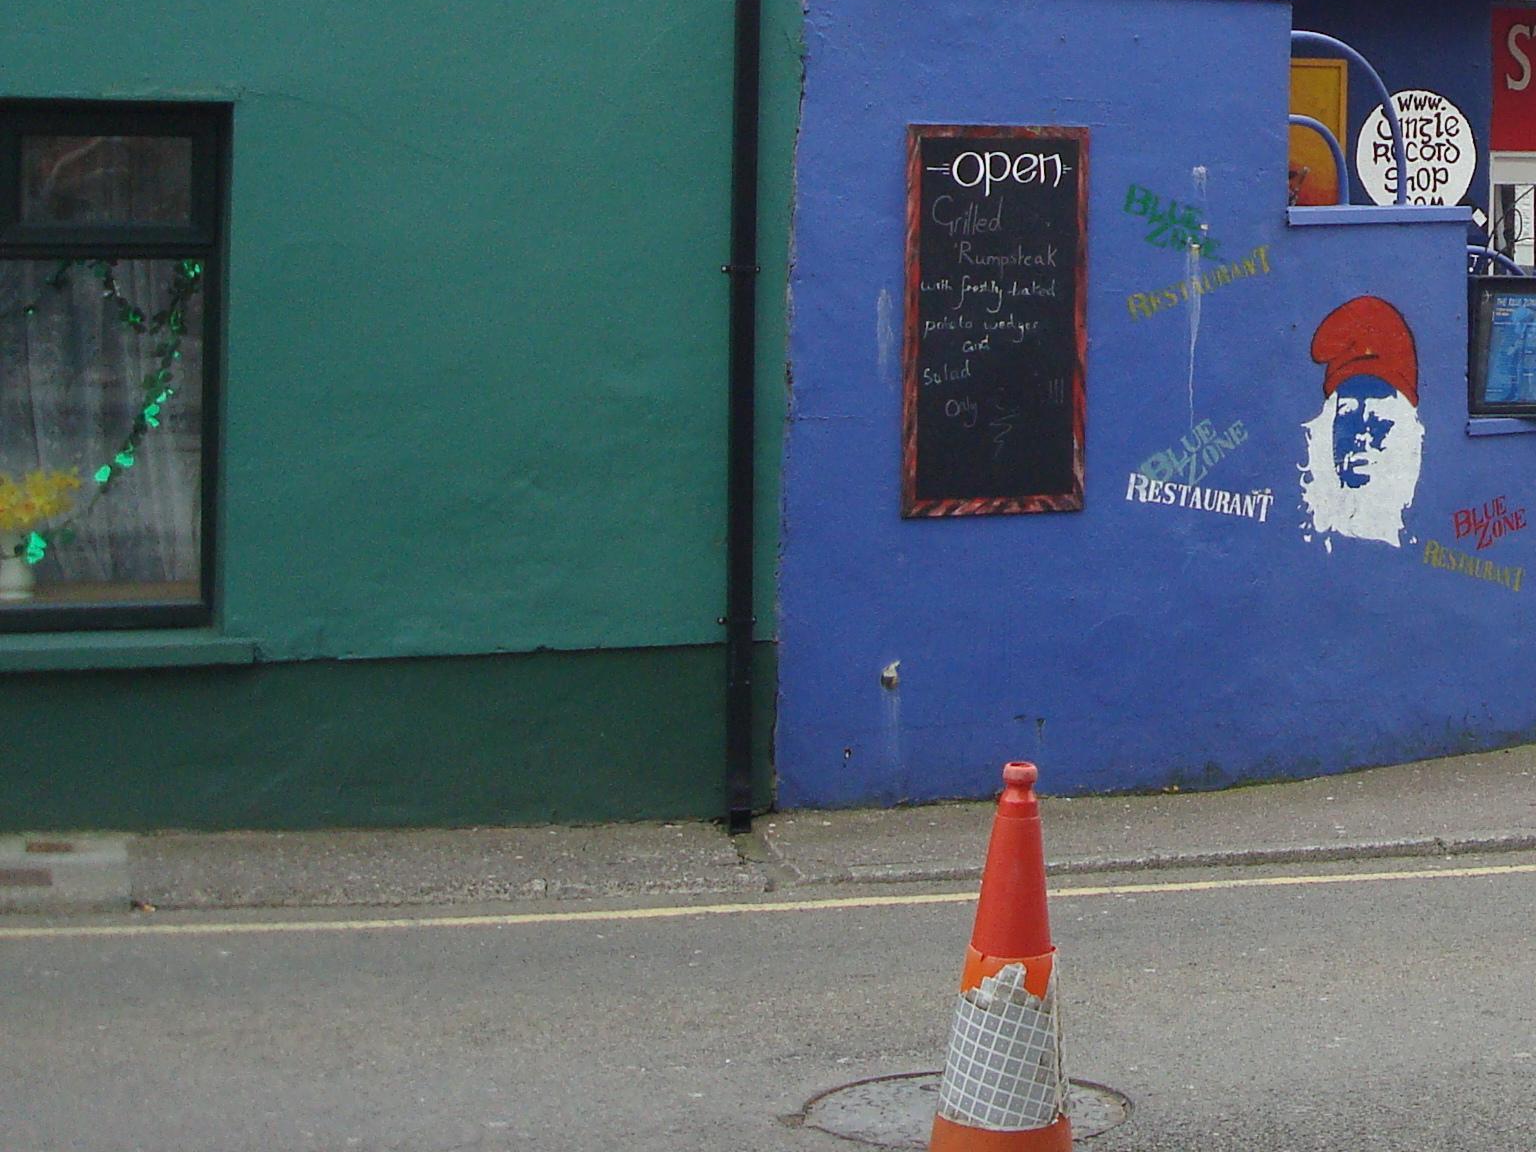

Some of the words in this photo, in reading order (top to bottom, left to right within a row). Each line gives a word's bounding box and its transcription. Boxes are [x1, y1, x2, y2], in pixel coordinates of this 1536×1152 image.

[1140, 418, 1217, 482] BLUE
[1186, 420, 1249, 486] ZONE
[1126, 472, 1274, 522] RESTAURANT
[1453, 496, 1507, 539] BLUE
[1476, 508, 1527, 550] ZONE
